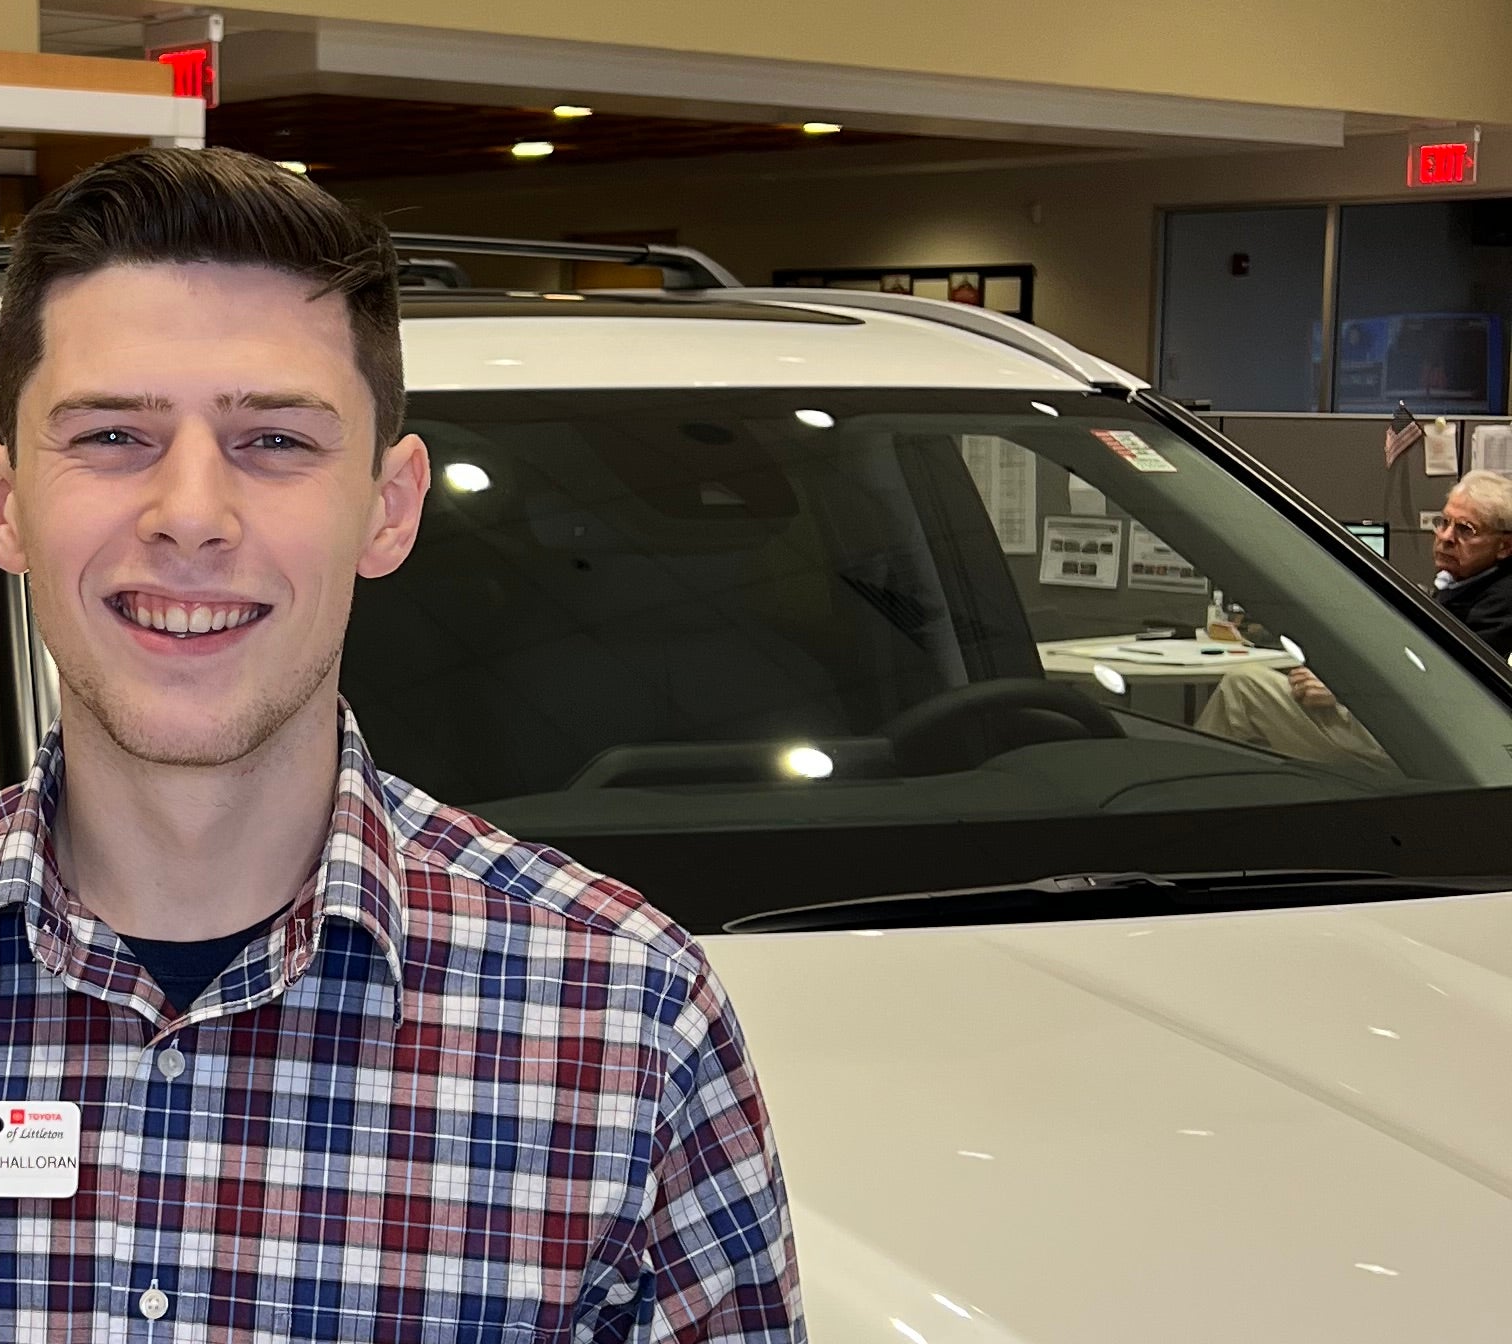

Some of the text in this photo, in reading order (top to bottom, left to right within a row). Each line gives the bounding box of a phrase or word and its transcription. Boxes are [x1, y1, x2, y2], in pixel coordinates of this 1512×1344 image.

[1420, 143, 1468, 184] EXIT
[28, 1113, 62, 1121] TOYOTA
[6, 1127, 64, 1143] of Littleton
